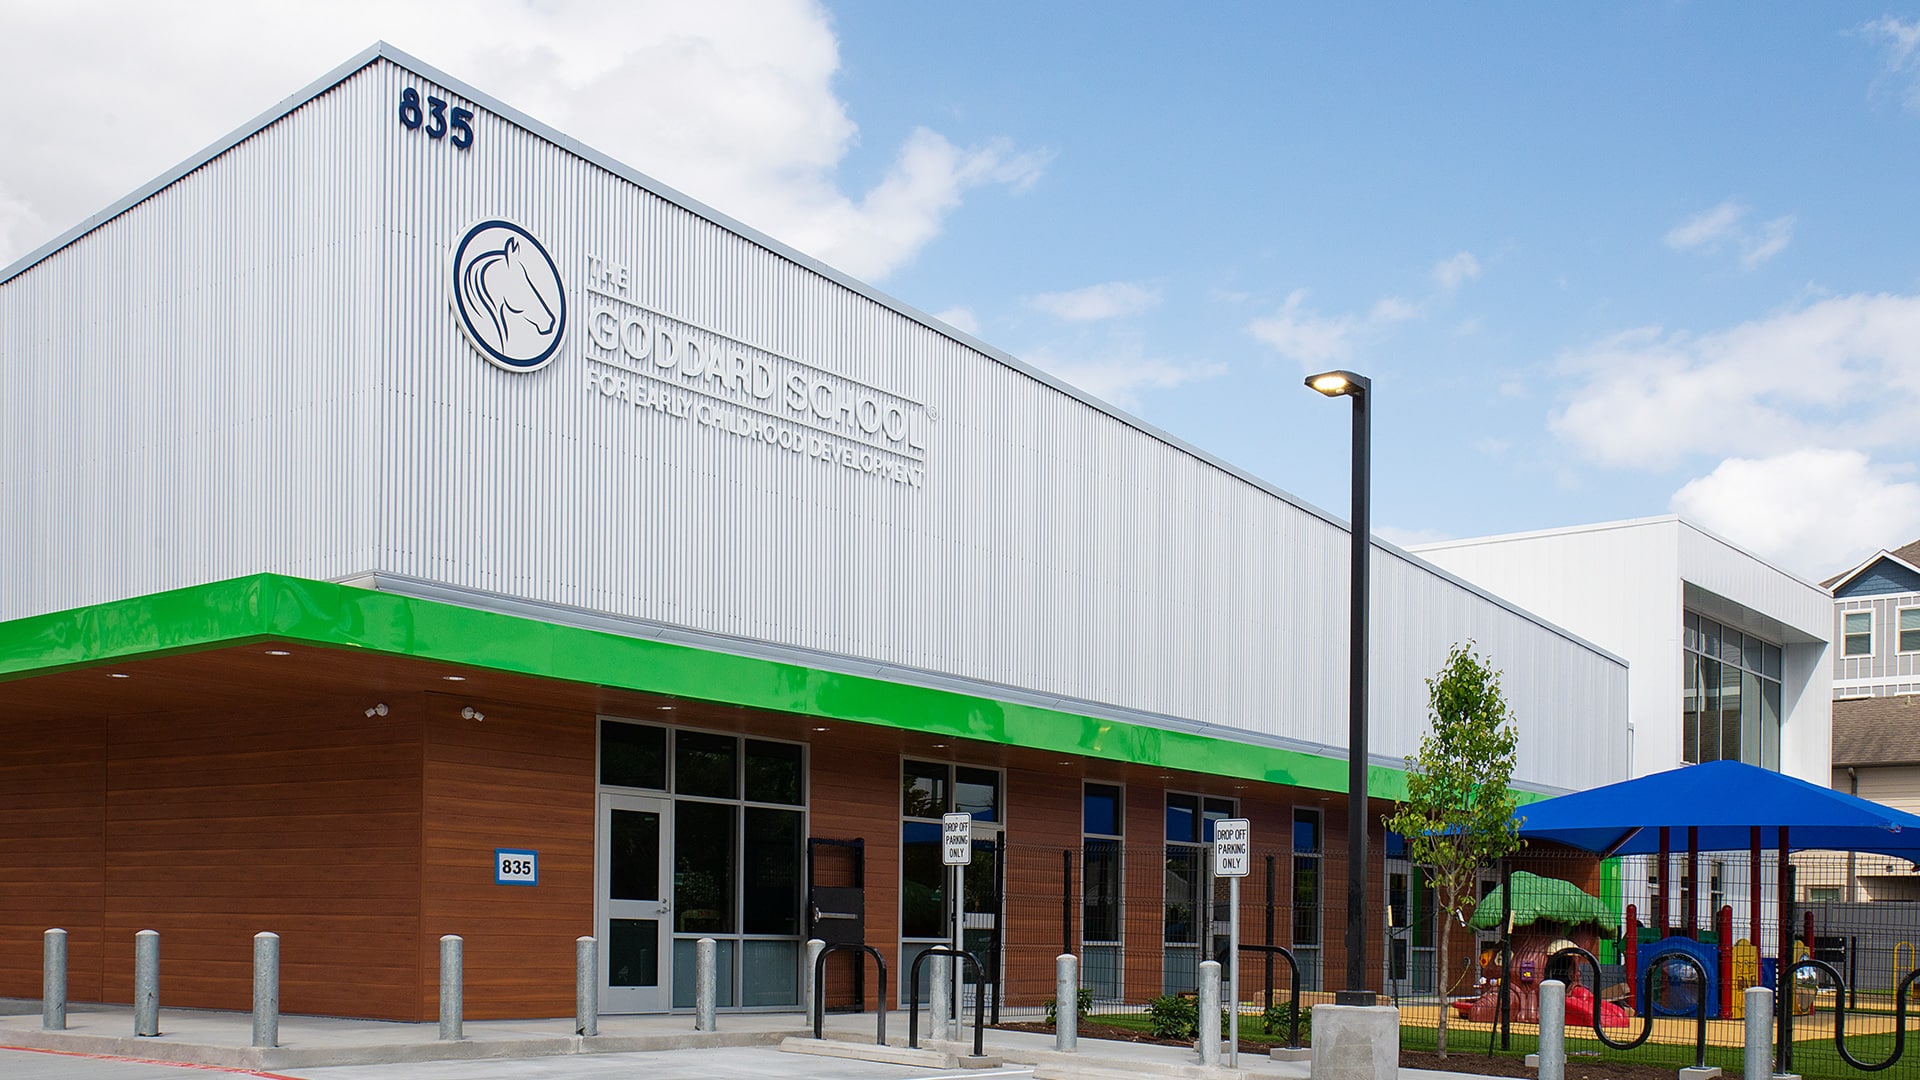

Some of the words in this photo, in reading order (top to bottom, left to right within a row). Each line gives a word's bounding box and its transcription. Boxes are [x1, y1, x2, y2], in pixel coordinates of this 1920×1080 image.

[399, 87, 474, 148] 835
[587, 255, 628, 289] THE
[588, 304, 777, 400] GODDARD
[786, 369, 924, 451] SCHOOL
[586, 370, 628, 403] FOR
[635, 385, 692, 419] EARLY
[696, 402, 804, 453] CHILDHOOD
[809, 436, 924, 489] DEVELOPMENT
[945, 822, 958, 832] DROP
[959, 822, 968, 832] OFF
[946, 834, 968, 845] PARKING
[1218, 829, 1234, 840] DROP
[1235, 829, 1246, 840] OFF
[949, 848, 964, 858] ONLY
[1218, 843, 1246, 854] PARKING
[502, 859, 531, 875] 835
[1222, 858, 1241, 869] ONLY
